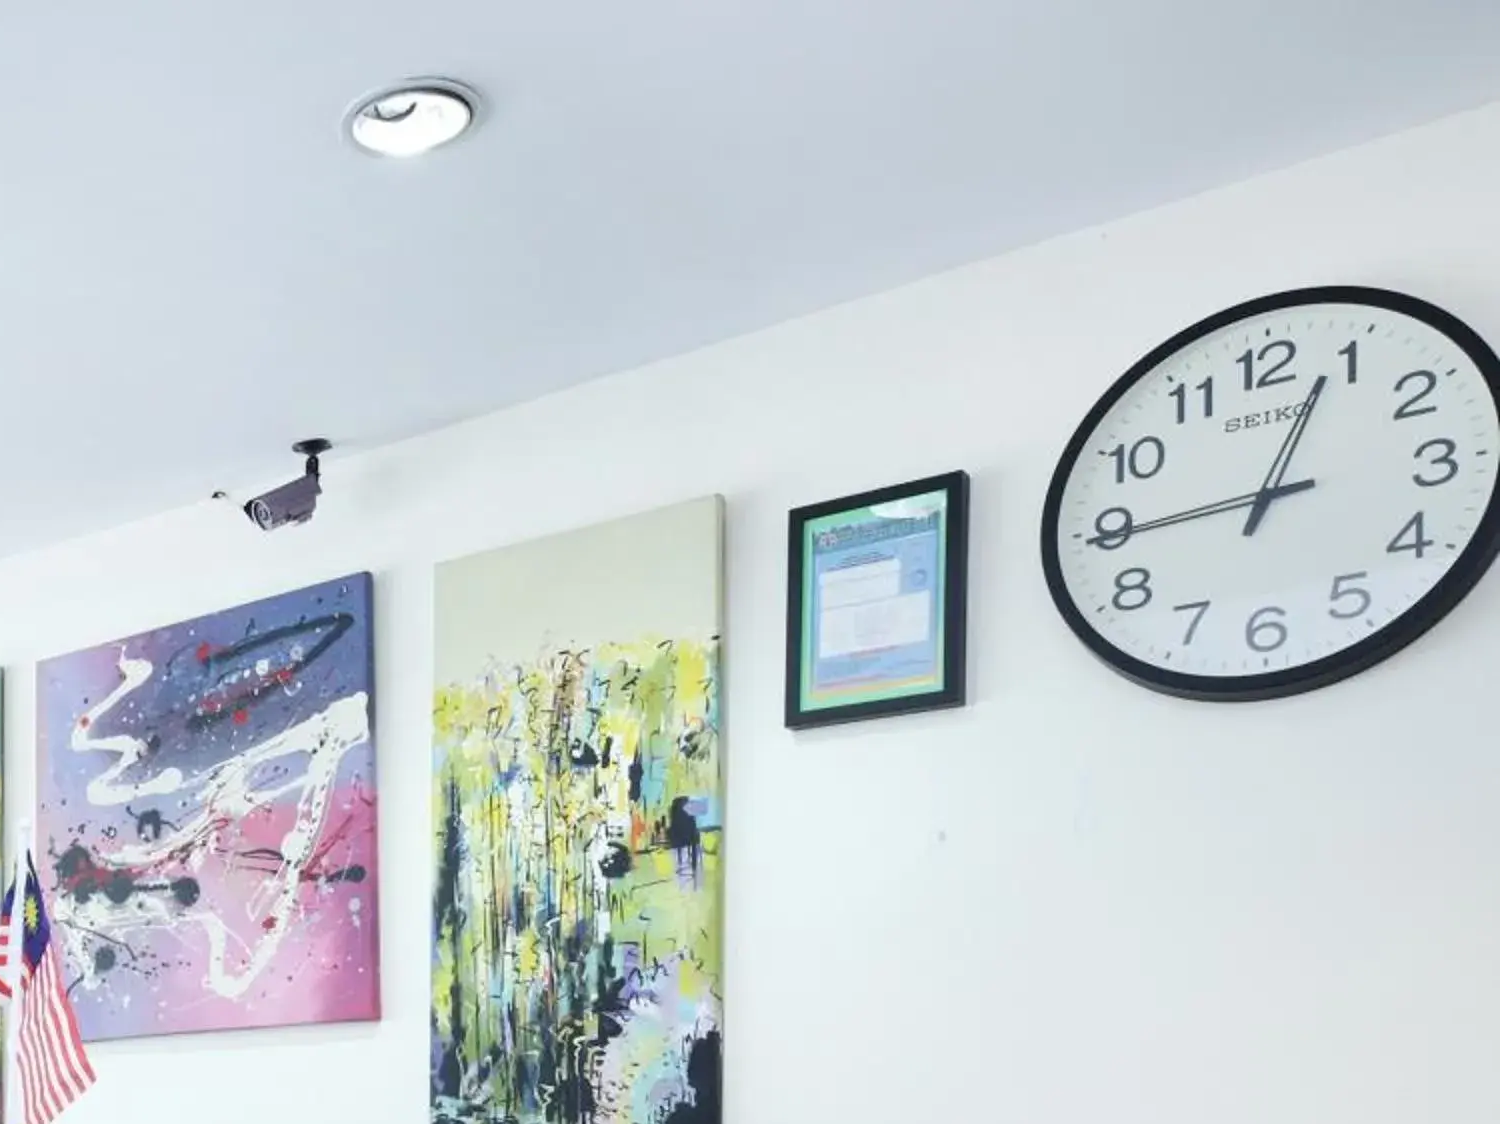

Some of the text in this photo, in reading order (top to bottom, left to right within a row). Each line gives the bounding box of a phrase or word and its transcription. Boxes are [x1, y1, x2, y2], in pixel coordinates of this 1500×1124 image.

[1236, 340, 1297, 391] 12
[1338, 340, 1357, 384] 1
[1168, 376, 1214, 425] 11
[1224, 401, 1312, 433] SEIKO
[1392, 369, 1438, 420] 2
[1107, 435, 1165, 483] 10
[1413, 438, 1459, 487] 3
[1093, 506, 1133, 550] 9
[1386, 511, 1434, 558] 4
[1111, 567, 1152, 610] 8
[1329, 571, 1371, 618] 5
[1173, 600, 1211, 645] 7
[1245, 606, 1288, 652] 6
